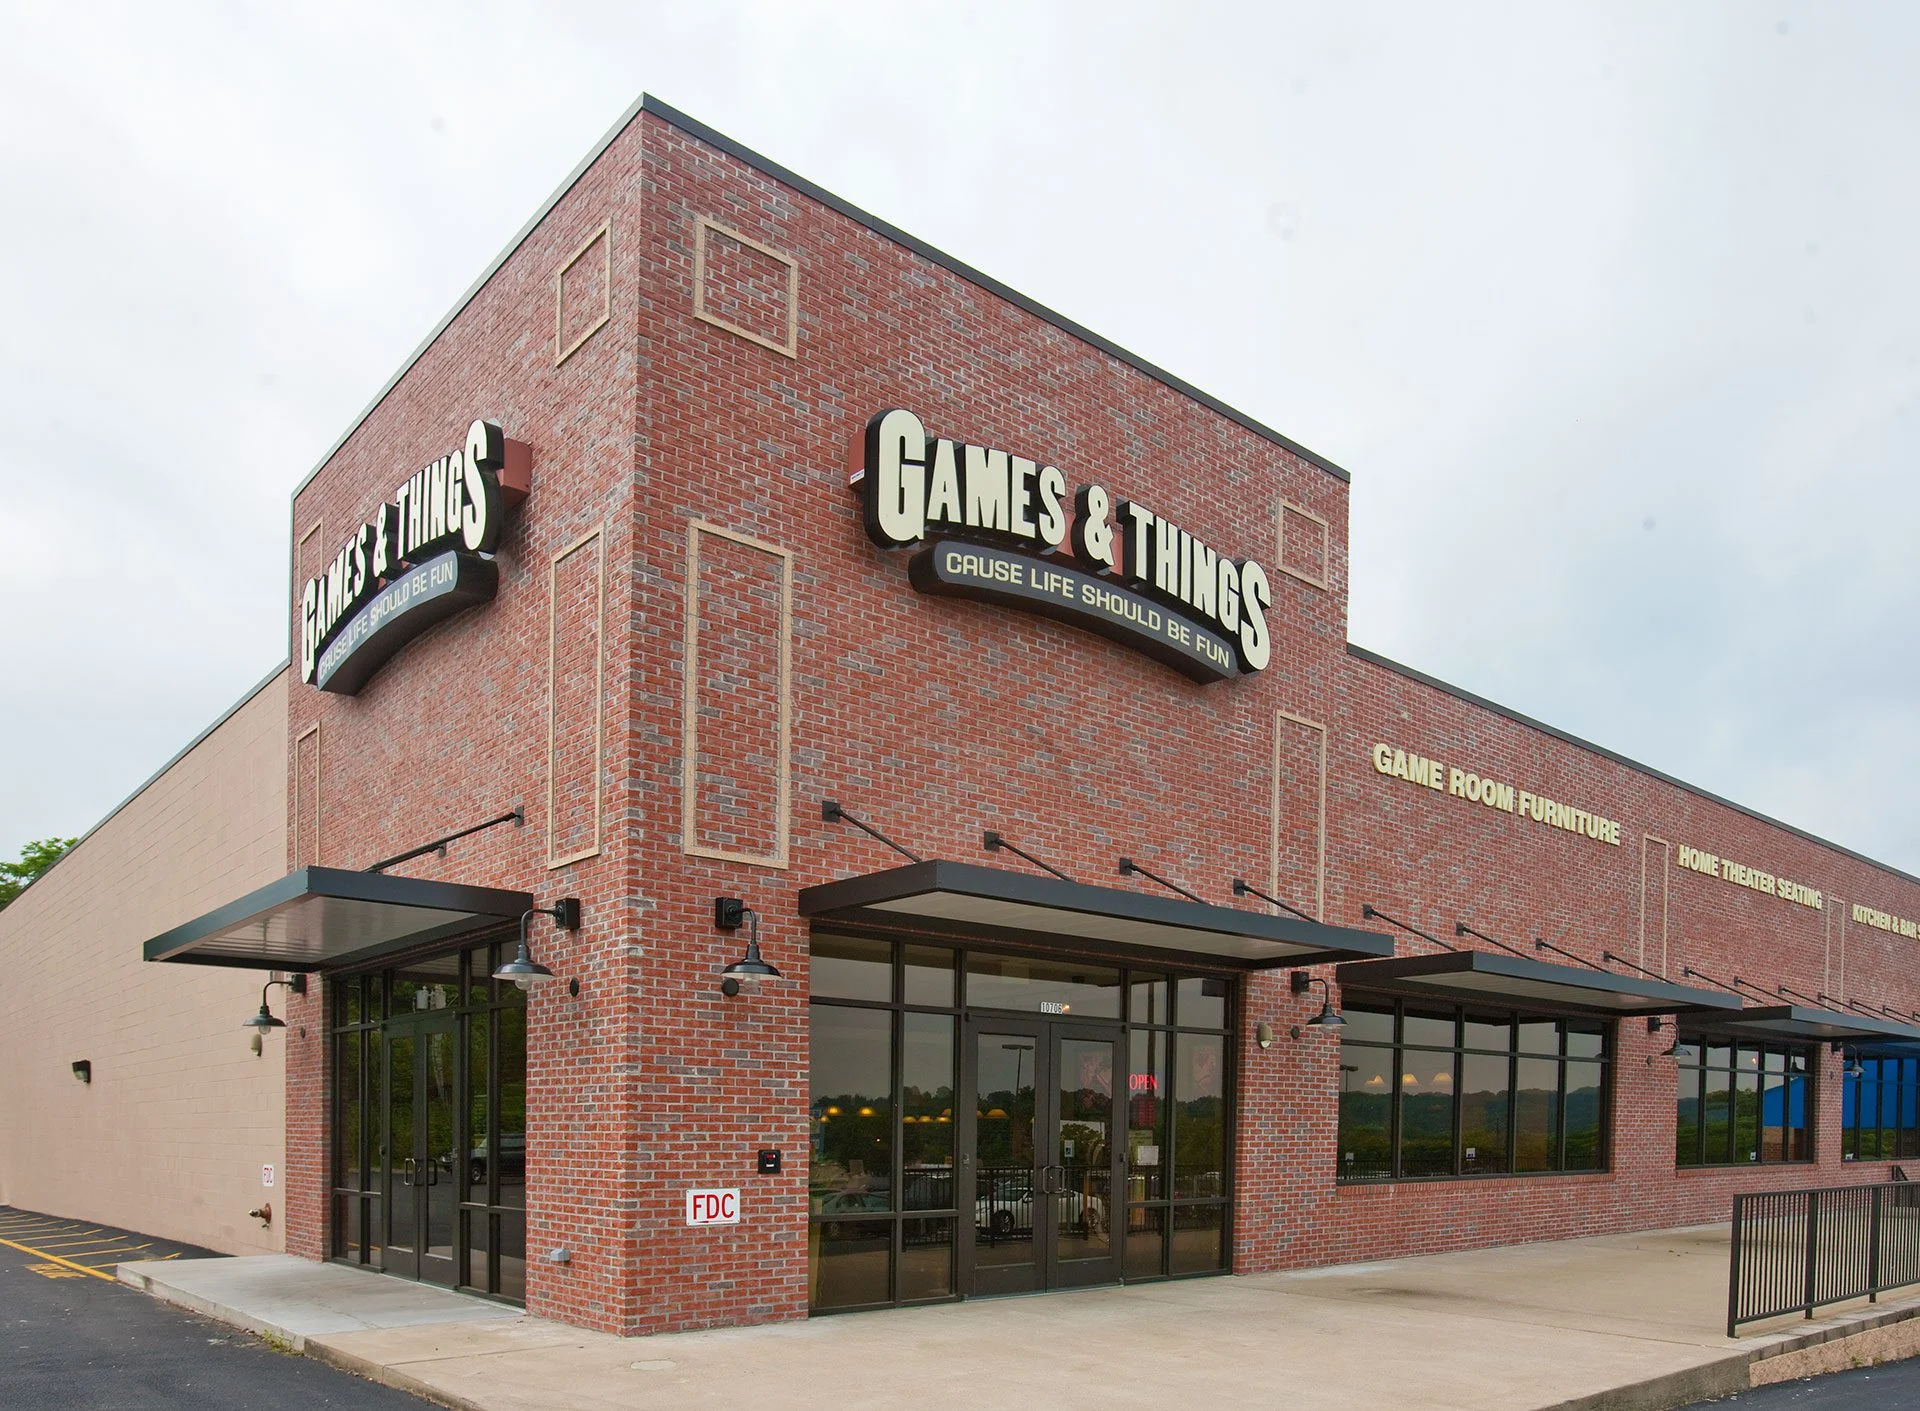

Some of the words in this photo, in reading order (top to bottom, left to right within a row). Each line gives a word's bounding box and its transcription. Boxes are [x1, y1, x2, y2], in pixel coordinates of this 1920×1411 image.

[301, 522, 368, 684] GAMES
[373, 502, 388, 577] &
[396, 419, 488, 560] THINGS
[878, 409, 1066, 546] GAMES
[1083, 485, 1115, 567] &
[1129, 501, 1271, 670] THINGS
[319, 635, 348, 680] CAUSE
[347, 615, 368, 644] LIFE
[370, 582, 410, 627] SHOULD
[412, 571, 428, 597] BE
[430, 560, 453, 588] FUN
[946, 552, 1022, 585] CAUSE
[1031, 568, 1074, 599] LIFE
[1082, 585, 1161, 632] SHOULD
[1168, 621, 1190, 647] BE
[1196, 633, 1230, 669] FUN
[1372, 743, 1443, 791] GAME
[1449, 767, 1513, 813] ROOM
[1518, 789, 1620, 847] FURNITURE
[1678, 844, 1719, 878] HOME
[1721, 858, 1776, 895] THEATER
[1777, 877, 1823, 910] SEATING
[1852, 903, 1891, 932] KITCHEN
[1892, 915, 1900, 934] &
[1900, 918, 1917, 940] BAR
[1129, 1073, 1158, 1091] OPEN
[692, 1193, 735, 1220] FDC
